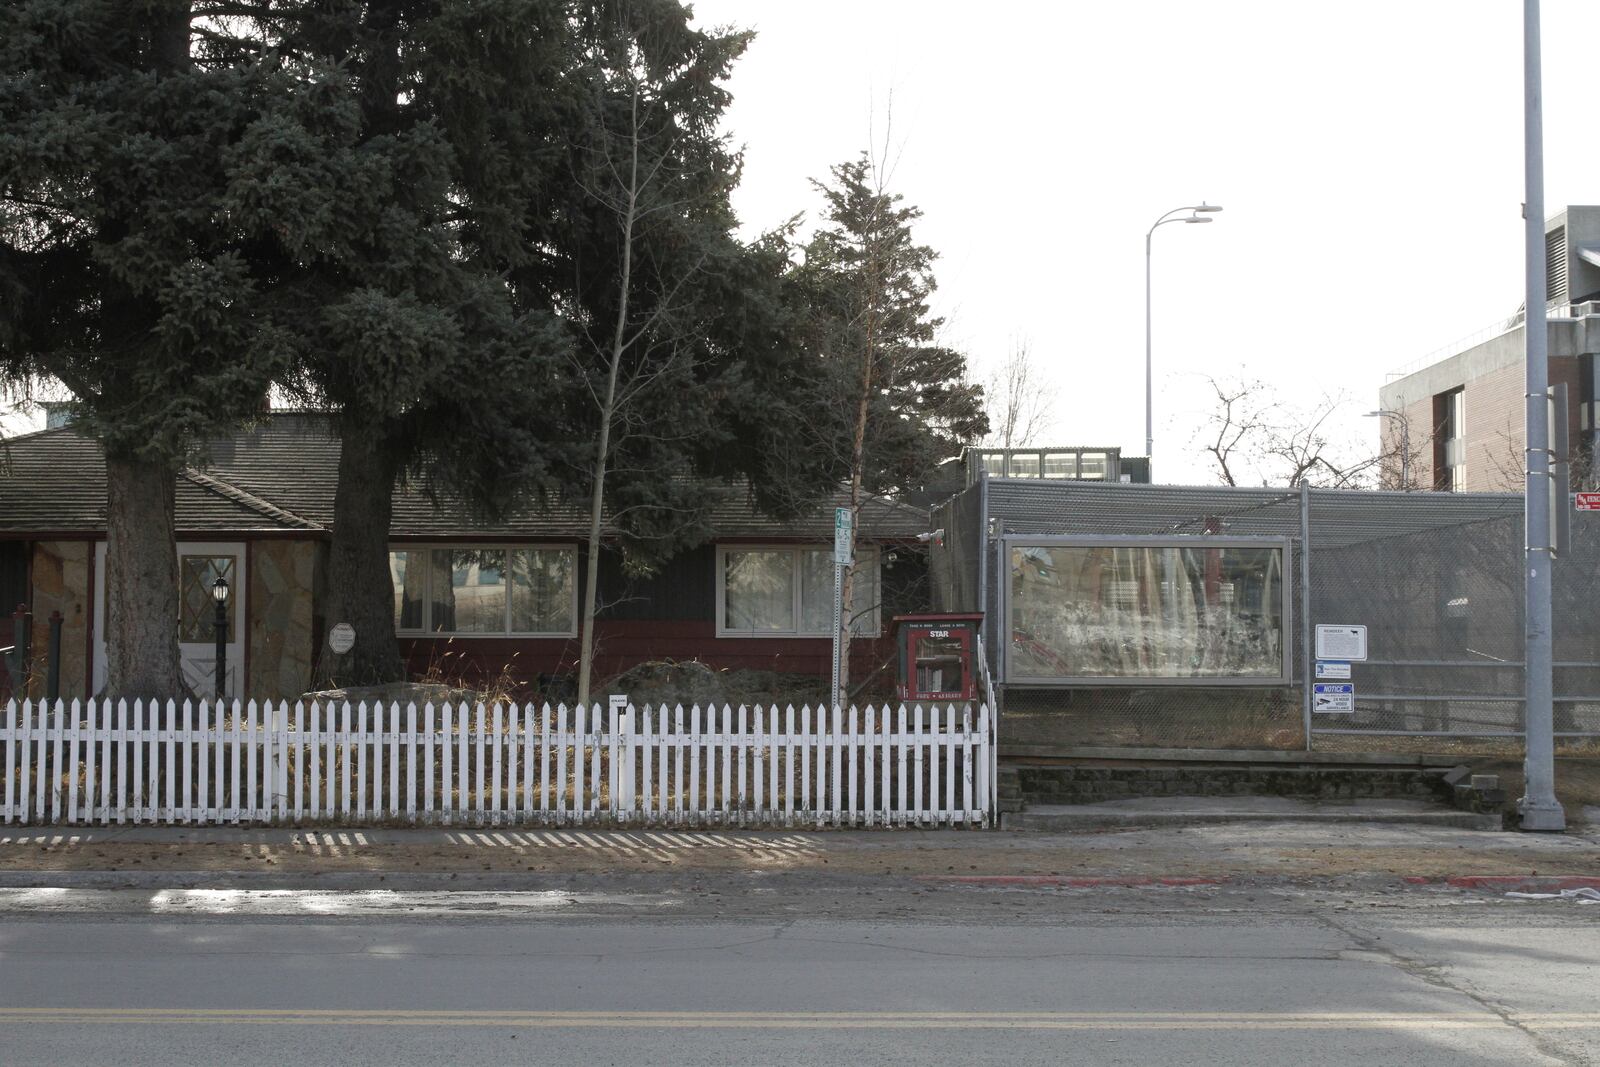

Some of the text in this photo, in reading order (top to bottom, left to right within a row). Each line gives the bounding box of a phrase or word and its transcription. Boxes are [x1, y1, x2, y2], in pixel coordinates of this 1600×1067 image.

[836, 512, 841, 526] 2
[930, 630, 949, 638] STAR
[1323, 685, 1344, 693] NOTICE
